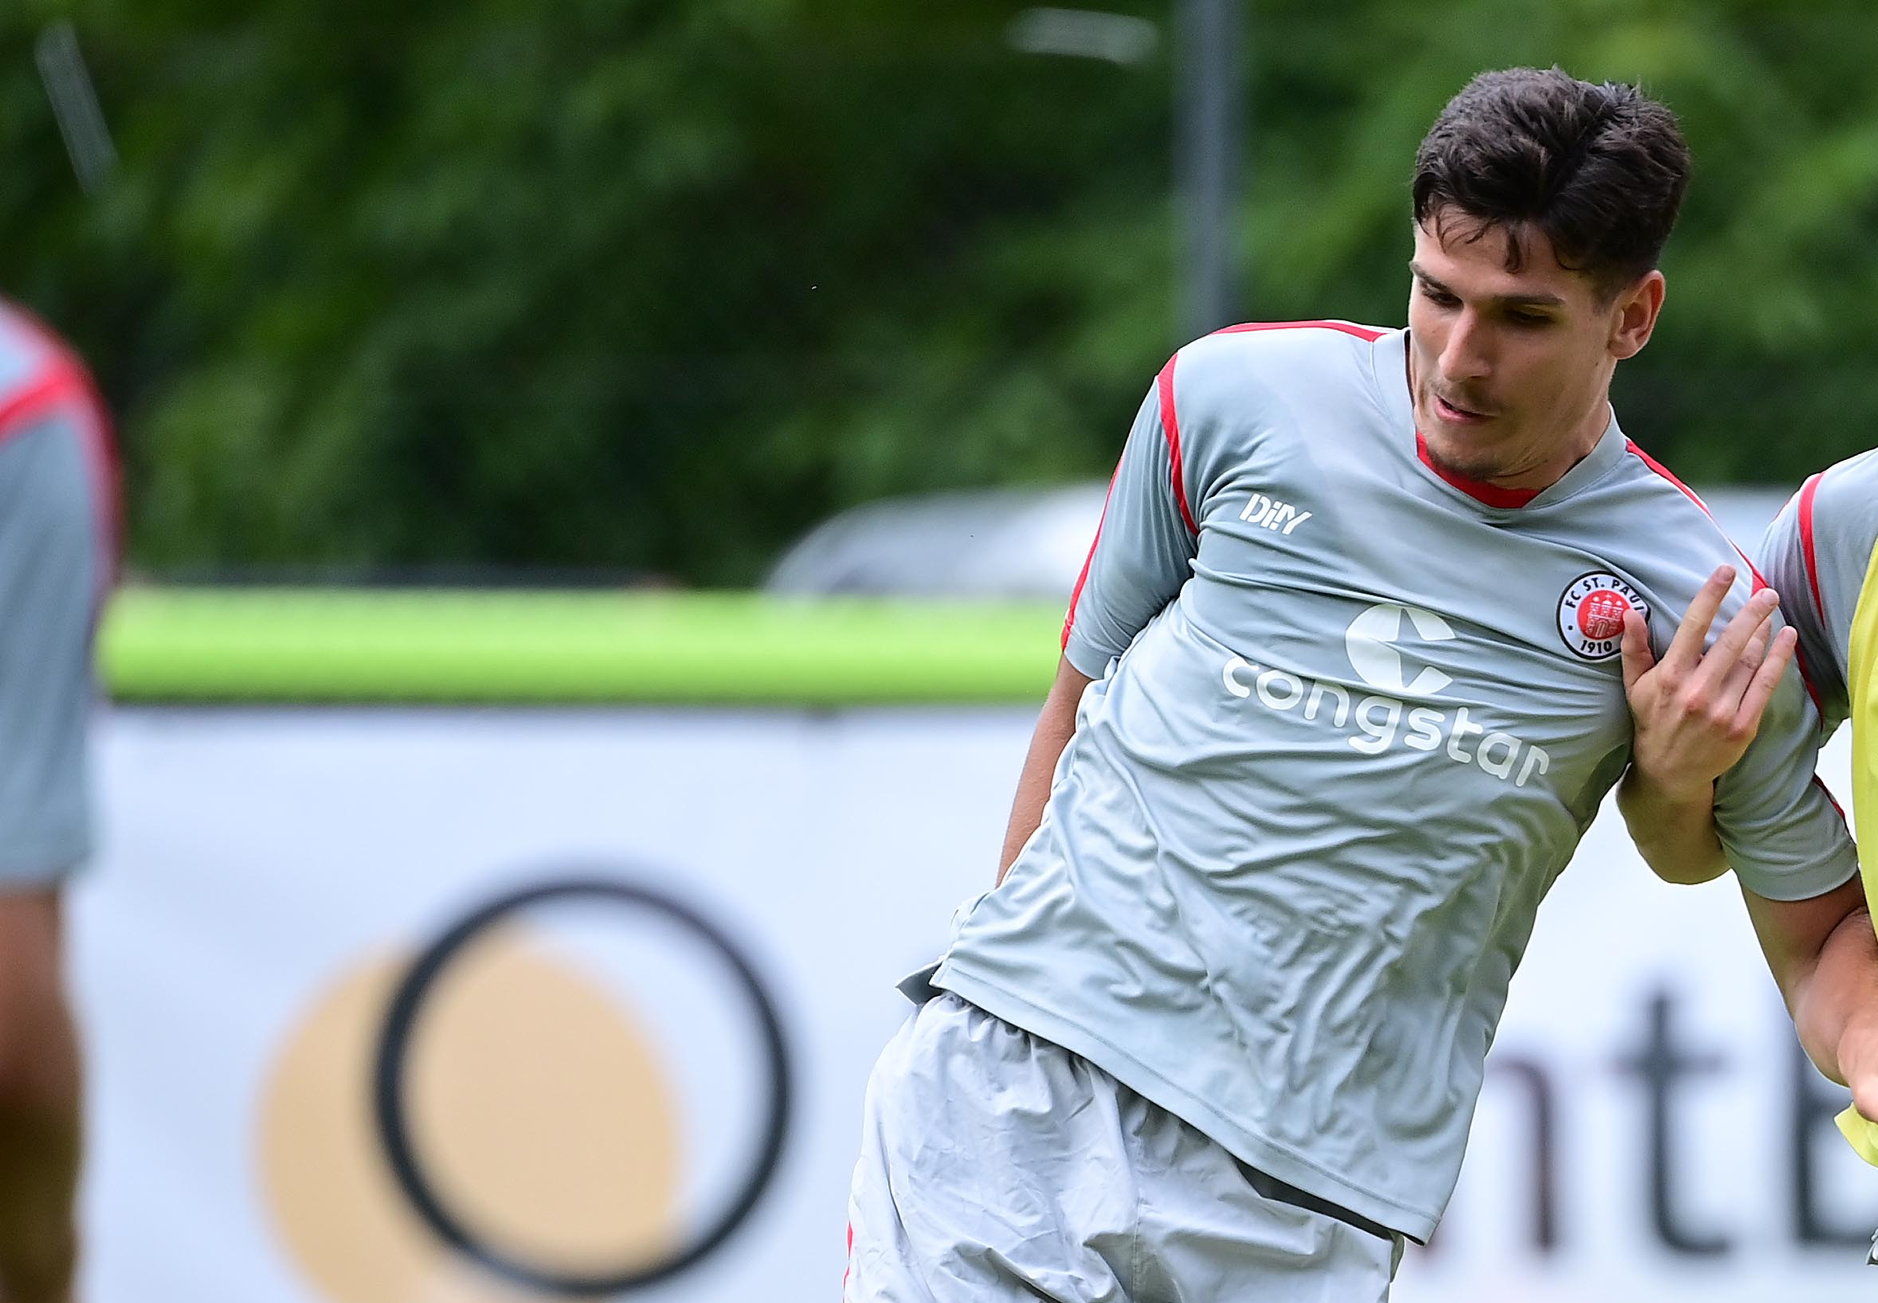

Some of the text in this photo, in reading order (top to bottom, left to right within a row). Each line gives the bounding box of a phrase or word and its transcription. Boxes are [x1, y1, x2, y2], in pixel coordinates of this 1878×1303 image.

[1565, 577, 1645, 611] FC ST. PAUL
[1580, 639, 1613, 654] 1910
[1222, 656, 1550, 787] congstar
